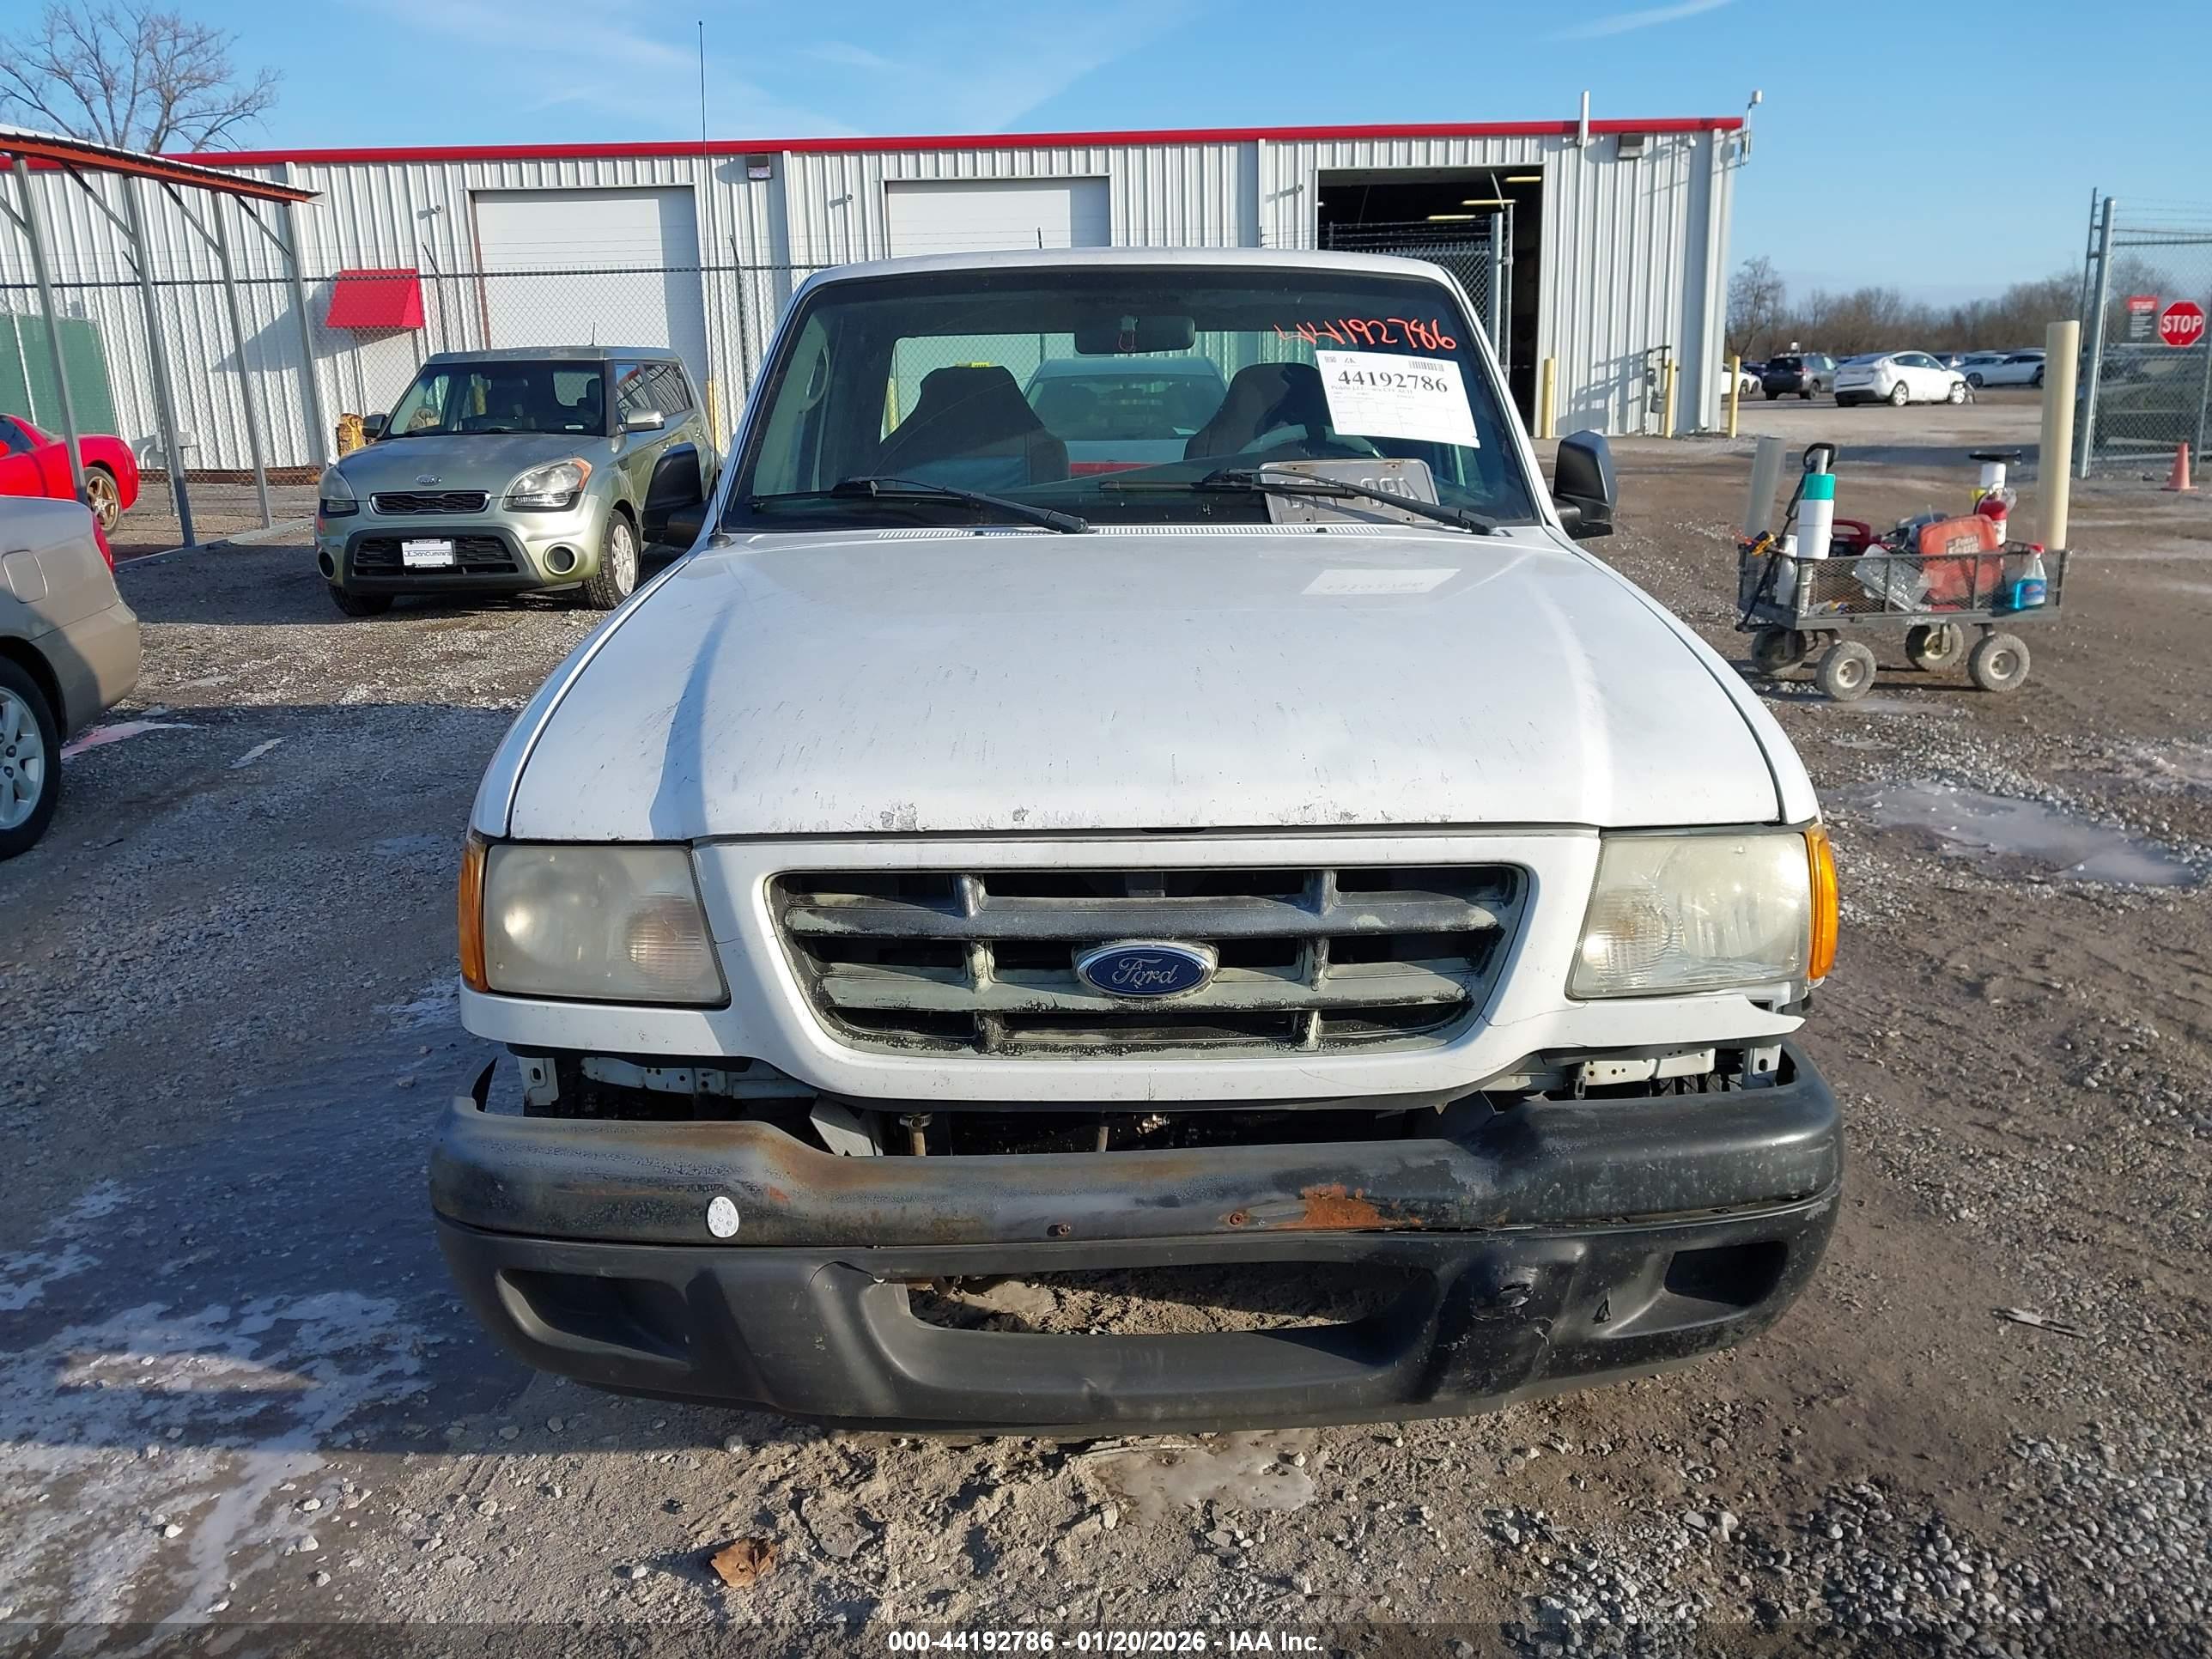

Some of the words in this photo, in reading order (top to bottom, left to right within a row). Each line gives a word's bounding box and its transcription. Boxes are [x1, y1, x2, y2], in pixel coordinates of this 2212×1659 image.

[1273, 319, 1456, 349] 44192786
[2162, 315, 2203, 333] STOP
[1338, 370, 1448, 392] 44192786
[1112, 957, 1177, 988] Ford
